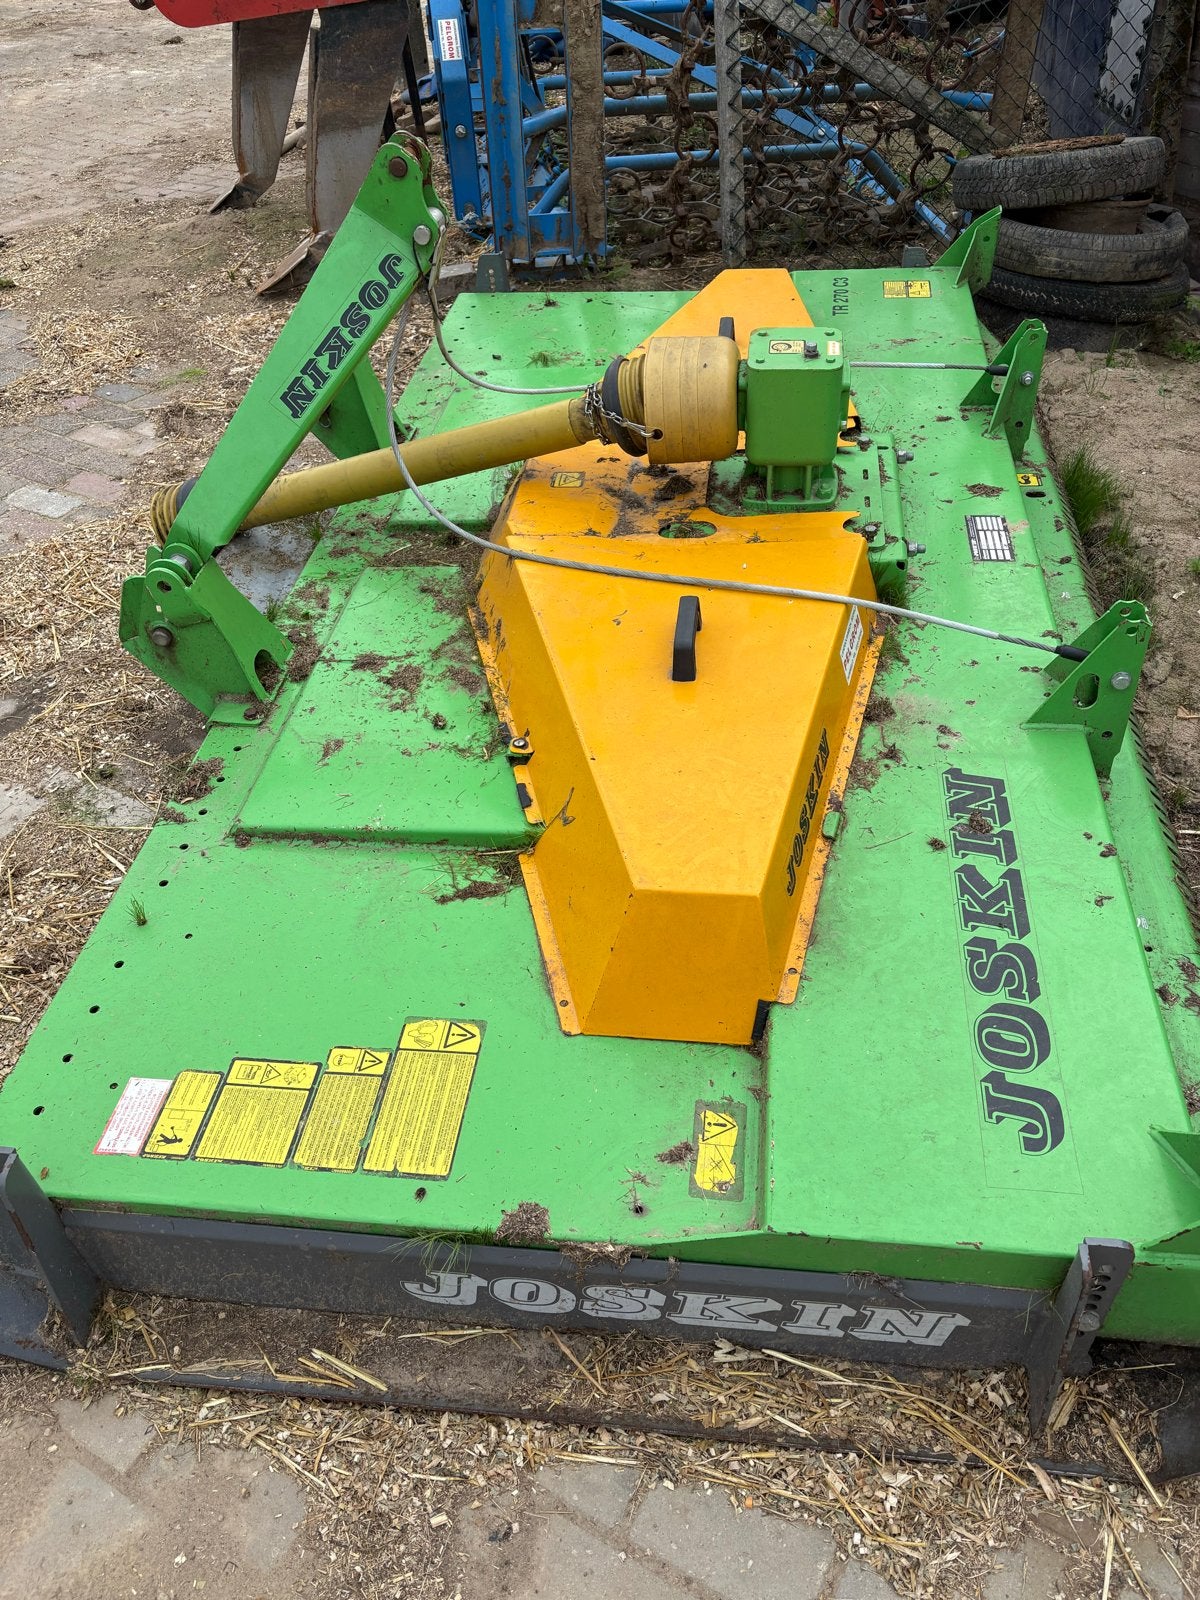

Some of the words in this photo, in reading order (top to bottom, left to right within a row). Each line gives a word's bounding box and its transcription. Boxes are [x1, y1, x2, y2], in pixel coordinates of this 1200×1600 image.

[445, 21, 455, 59] PELGROM
[832, 305, 849, 316] TR
[833, 277, 849, 287] C3
[833, 289, 849, 303] 270
[280, 253, 404, 418] JOSKIN
[787, 728, 829, 896] JOSKIN
[942, 768, 1065, 1156] JOSKIN
[400, 1270, 971, 1347] JOSKIN
